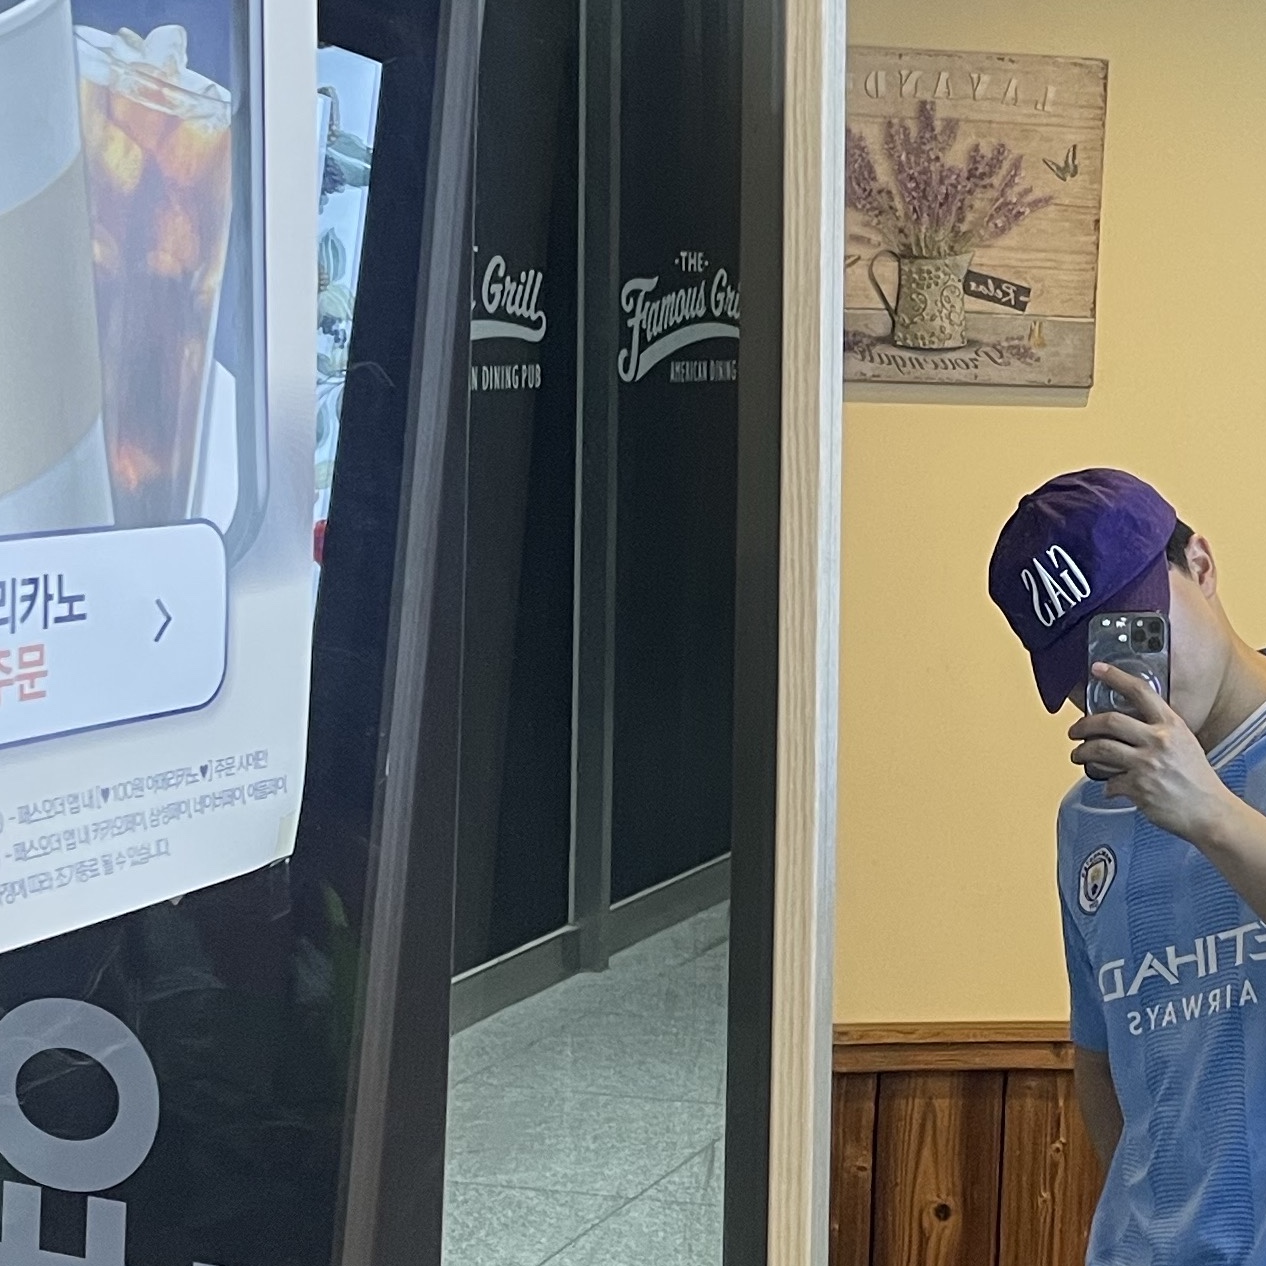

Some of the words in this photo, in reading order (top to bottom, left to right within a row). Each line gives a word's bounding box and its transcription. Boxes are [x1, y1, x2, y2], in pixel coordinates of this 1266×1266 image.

[680, 251, 705, 272] THE
[482, 255, 545, 322] Grill
[618, 275, 707, 383] Famous
[482, 364, 519, 391] DINING
[521, 363, 542, 388] PUB
[670, 361, 708, 383] AMERICAN
[710, 360, 738, 381] DINING
